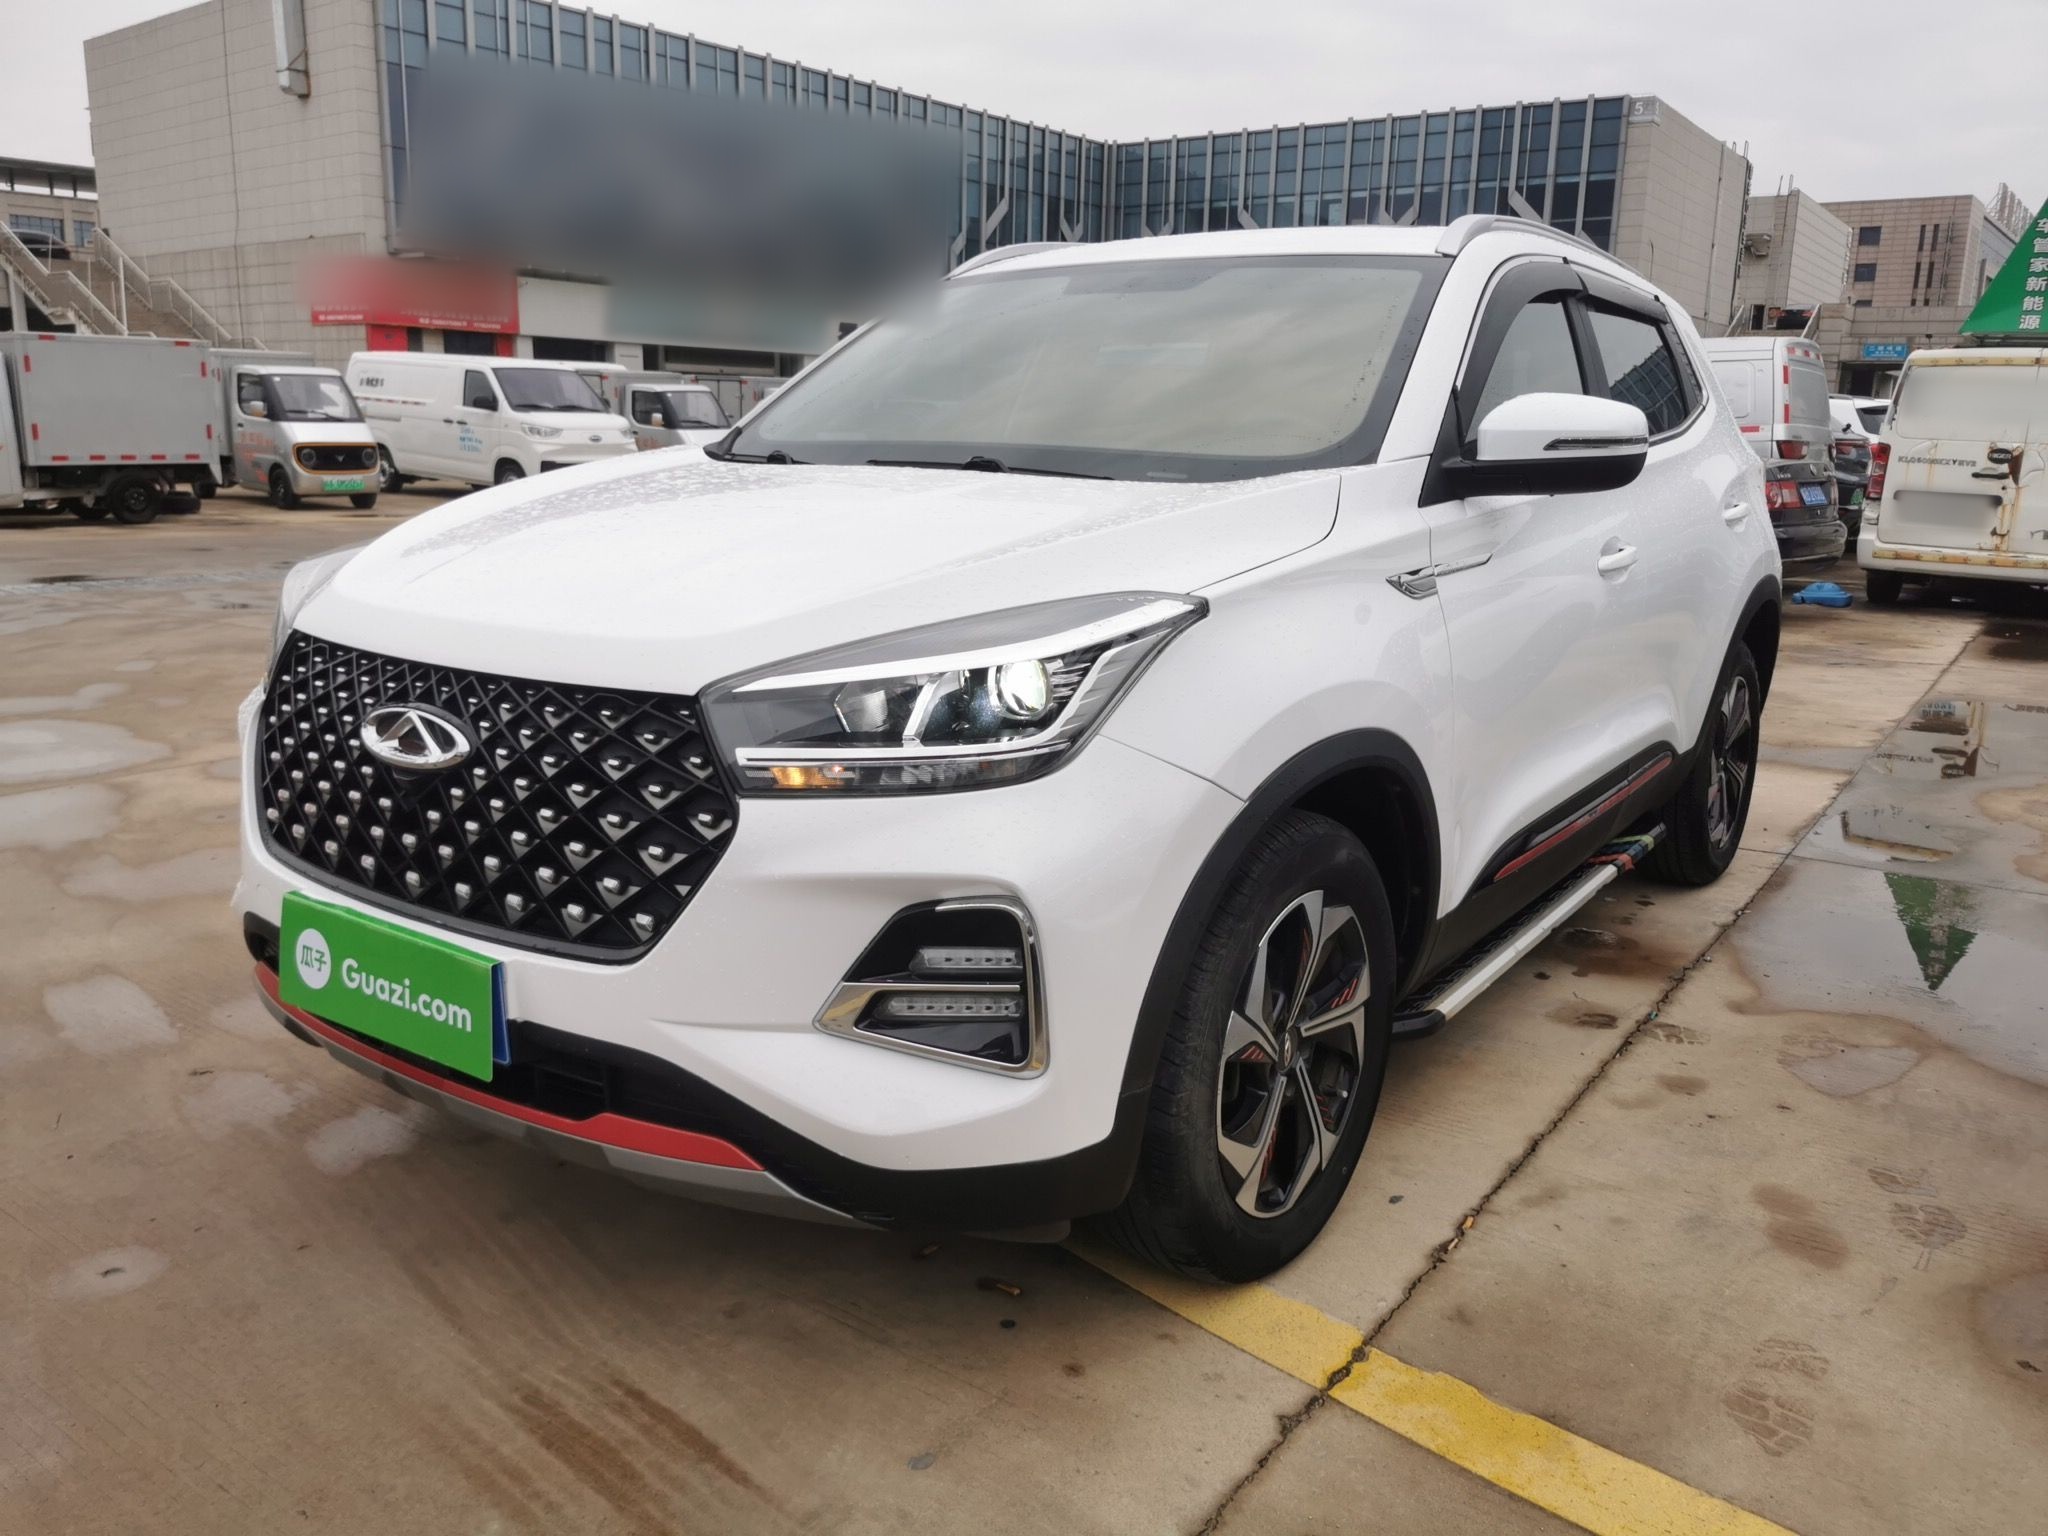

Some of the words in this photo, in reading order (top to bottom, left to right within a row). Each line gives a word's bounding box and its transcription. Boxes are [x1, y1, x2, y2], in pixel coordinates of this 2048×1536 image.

[1634, 102, 1644, 115] 5
[301, 945, 327, 972] 瓜子
[342, 958, 472, 1032] Guazi.com
